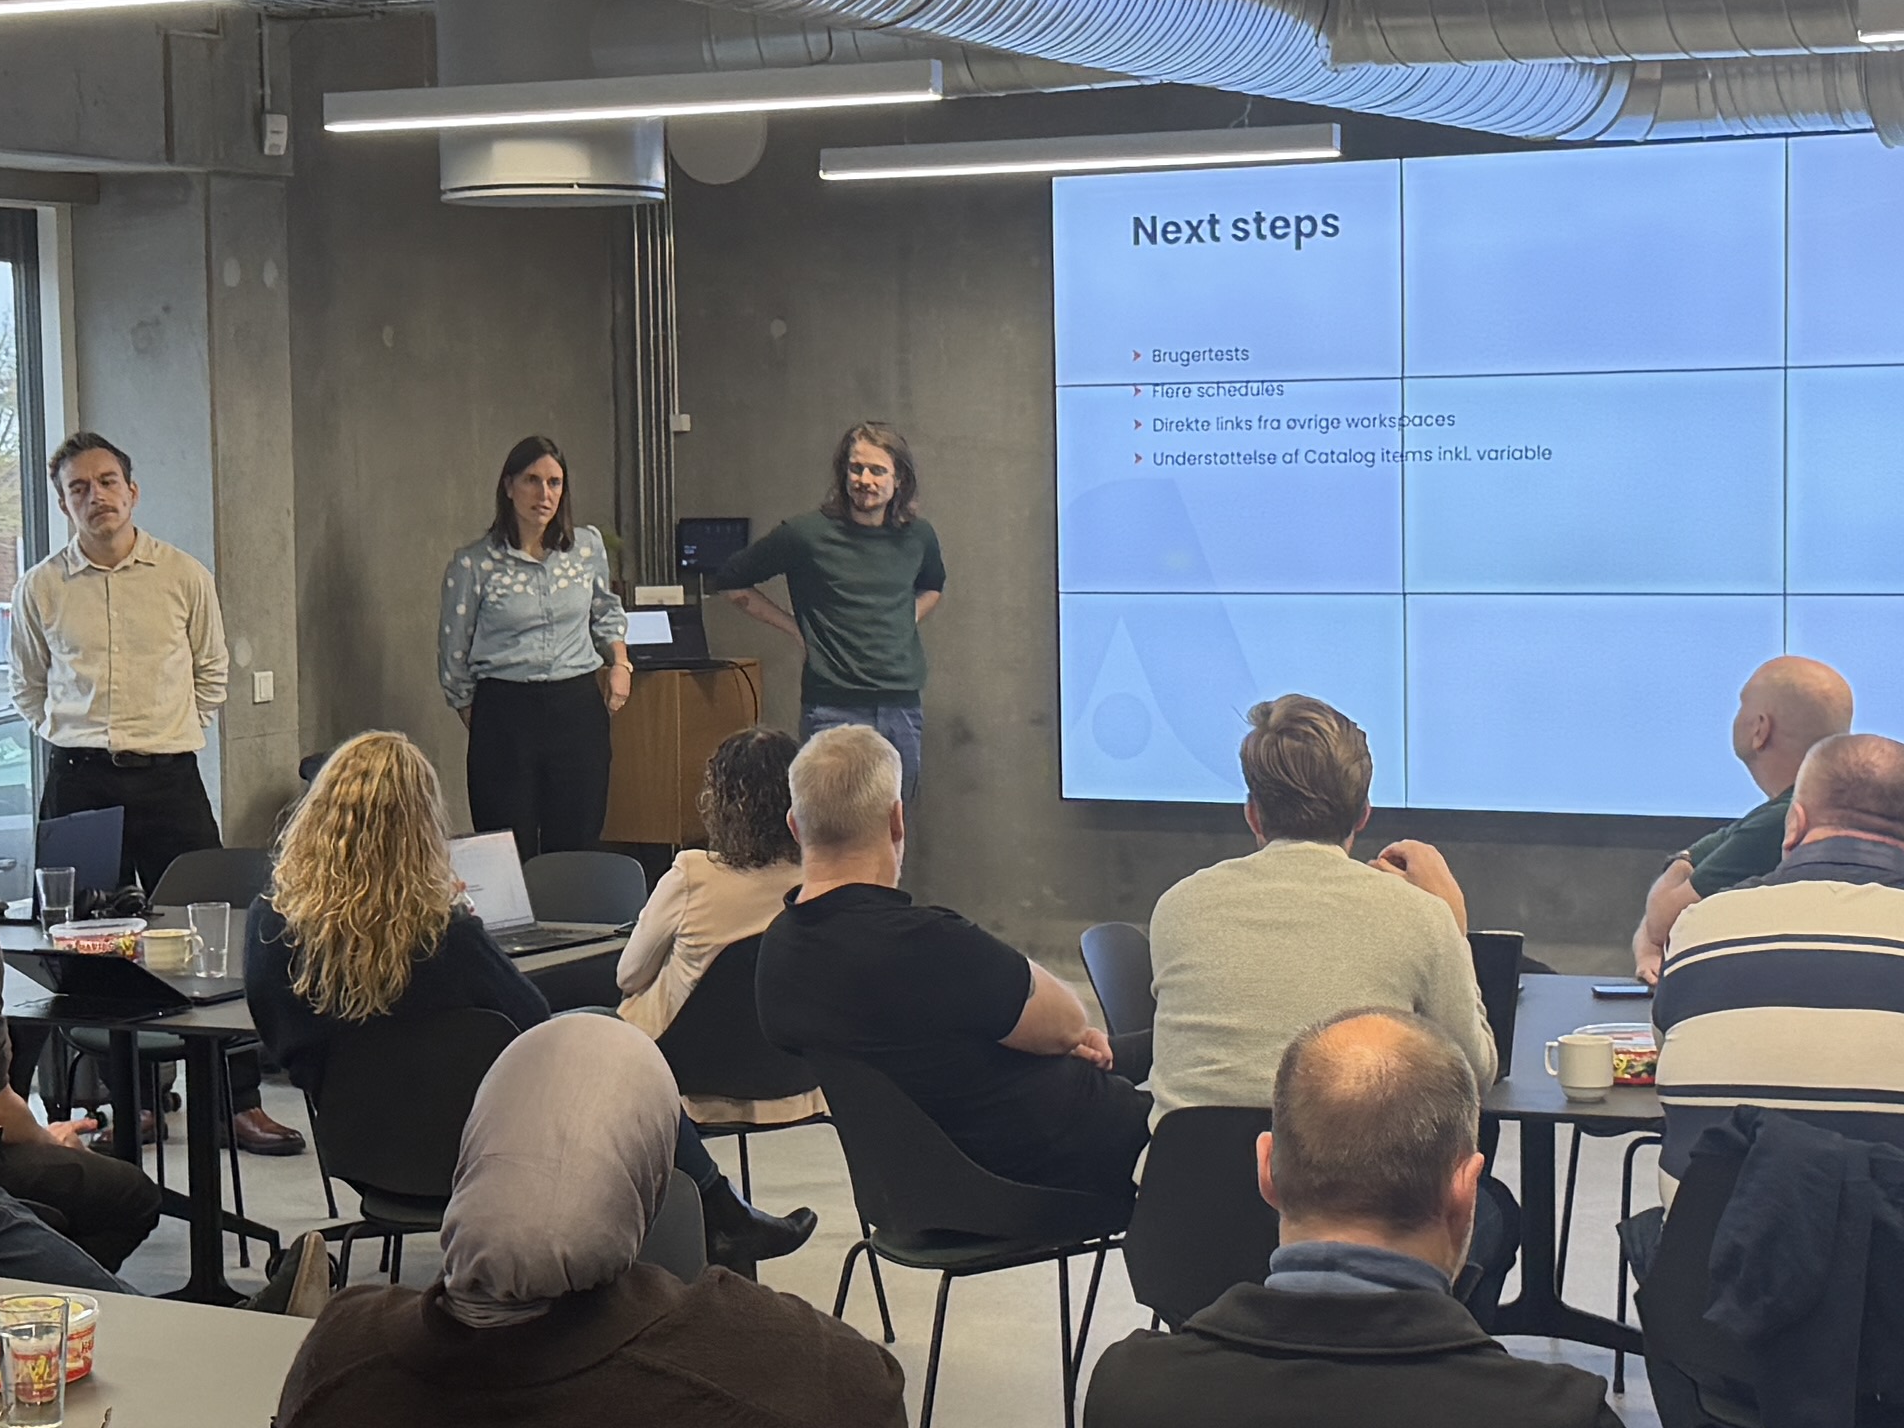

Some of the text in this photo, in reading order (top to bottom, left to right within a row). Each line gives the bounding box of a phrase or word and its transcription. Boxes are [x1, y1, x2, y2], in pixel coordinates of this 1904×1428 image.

[1133, 211, 1340, 251] Next steps
[1152, 347, 1250, 367] Brugertests
[1152, 381, 1284, 398] Flere schedules
[1152, 417, 1211, 432] Direkte
[1216, 416, 1253, 431] links
[1258, 414, 1281, 430] fra
[1345, 413, 1456, 432] workspaces
[1282, 448, 1300, 464] af
[1304, 448, 1376, 468] Catalog
[1438, 445, 1472, 461] inkl.
[1477, 445, 1552, 461] variable
